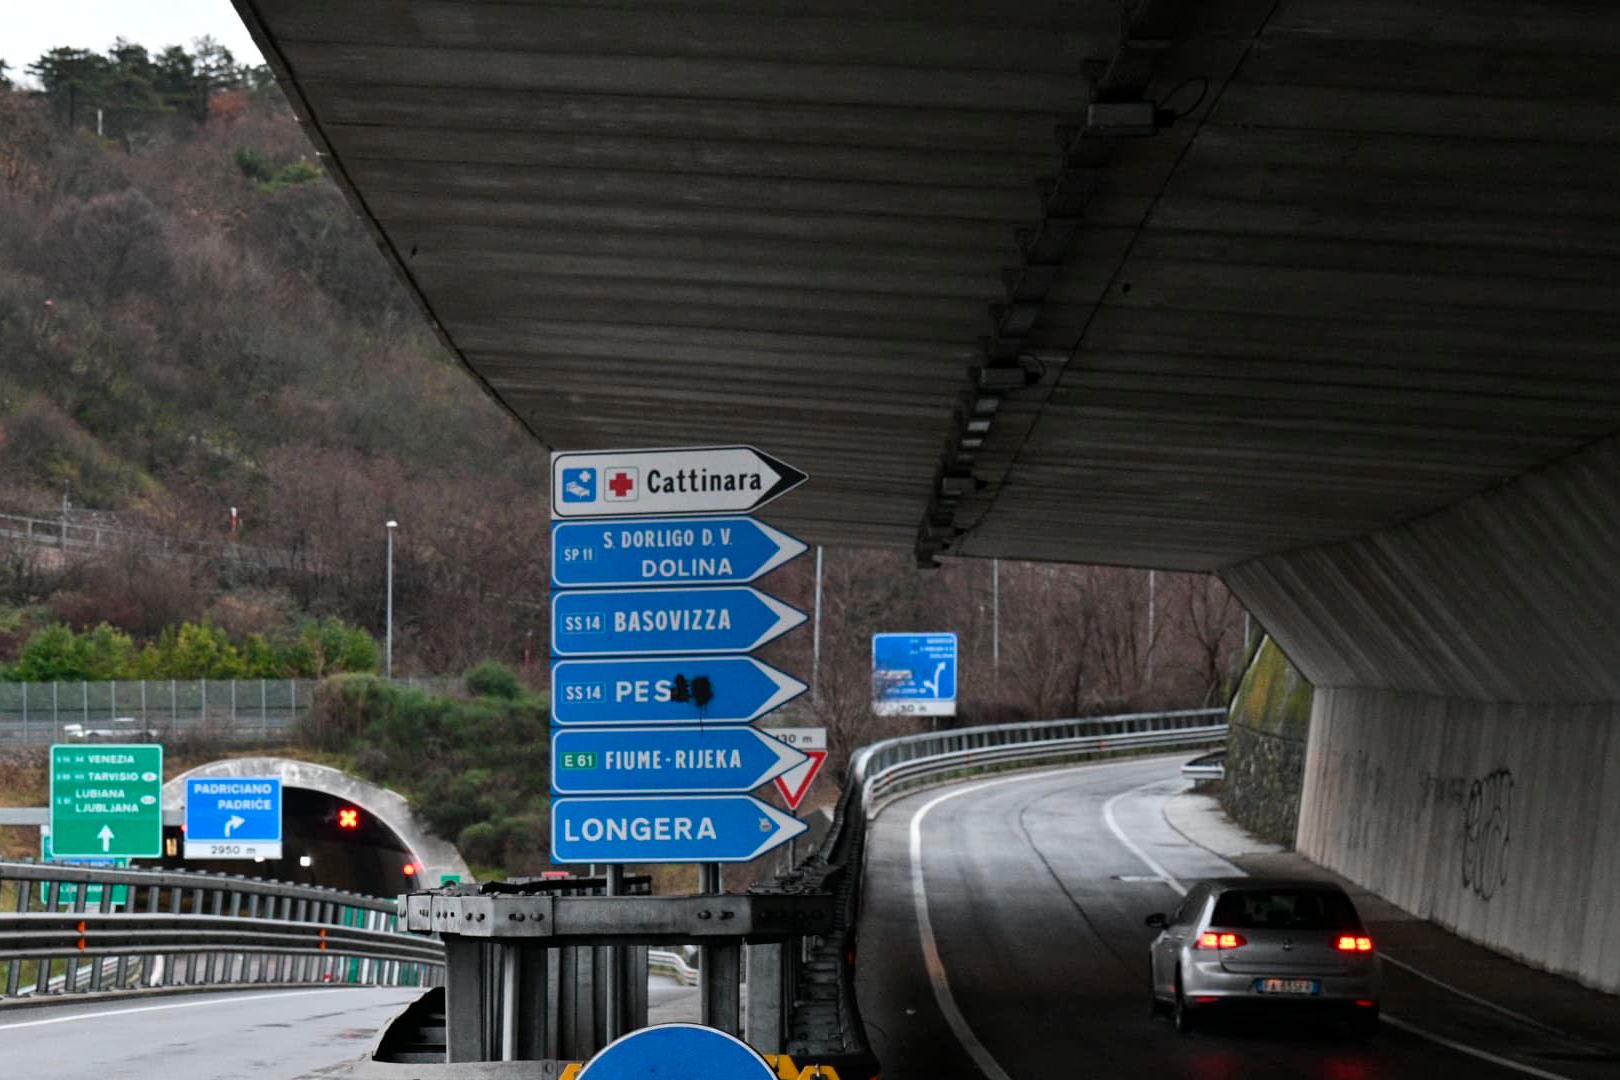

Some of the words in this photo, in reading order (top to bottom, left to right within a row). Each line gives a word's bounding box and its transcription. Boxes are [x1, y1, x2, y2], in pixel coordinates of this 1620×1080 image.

[646, 468, 762, 493] Cattinara
[603, 531, 616, 549] S.
[621, 529, 694, 548] DORLIGO
[702, 528, 716, 546] D.
[720, 528, 733, 545] V.
[564, 549, 580, 561] SP
[583, 548, 593, 560] 11
[641, 558, 733, 577] DOLINA
[614, 608, 732, 632] BASOVIZZA
[88, 754, 135, 764] VENEZIA
[565, 755, 573, 767] E
[577, 754, 593, 767] 61
[88, 772, 139, 781] TARVISIO
[75, 789, 125, 798] LUBIANA
[194, 783, 273, 794] PADRICIANO
[75, 803, 139, 813] LJUBLJANA
[564, 816, 717, 841] LONGERA
[211, 846, 240, 855] 2950
